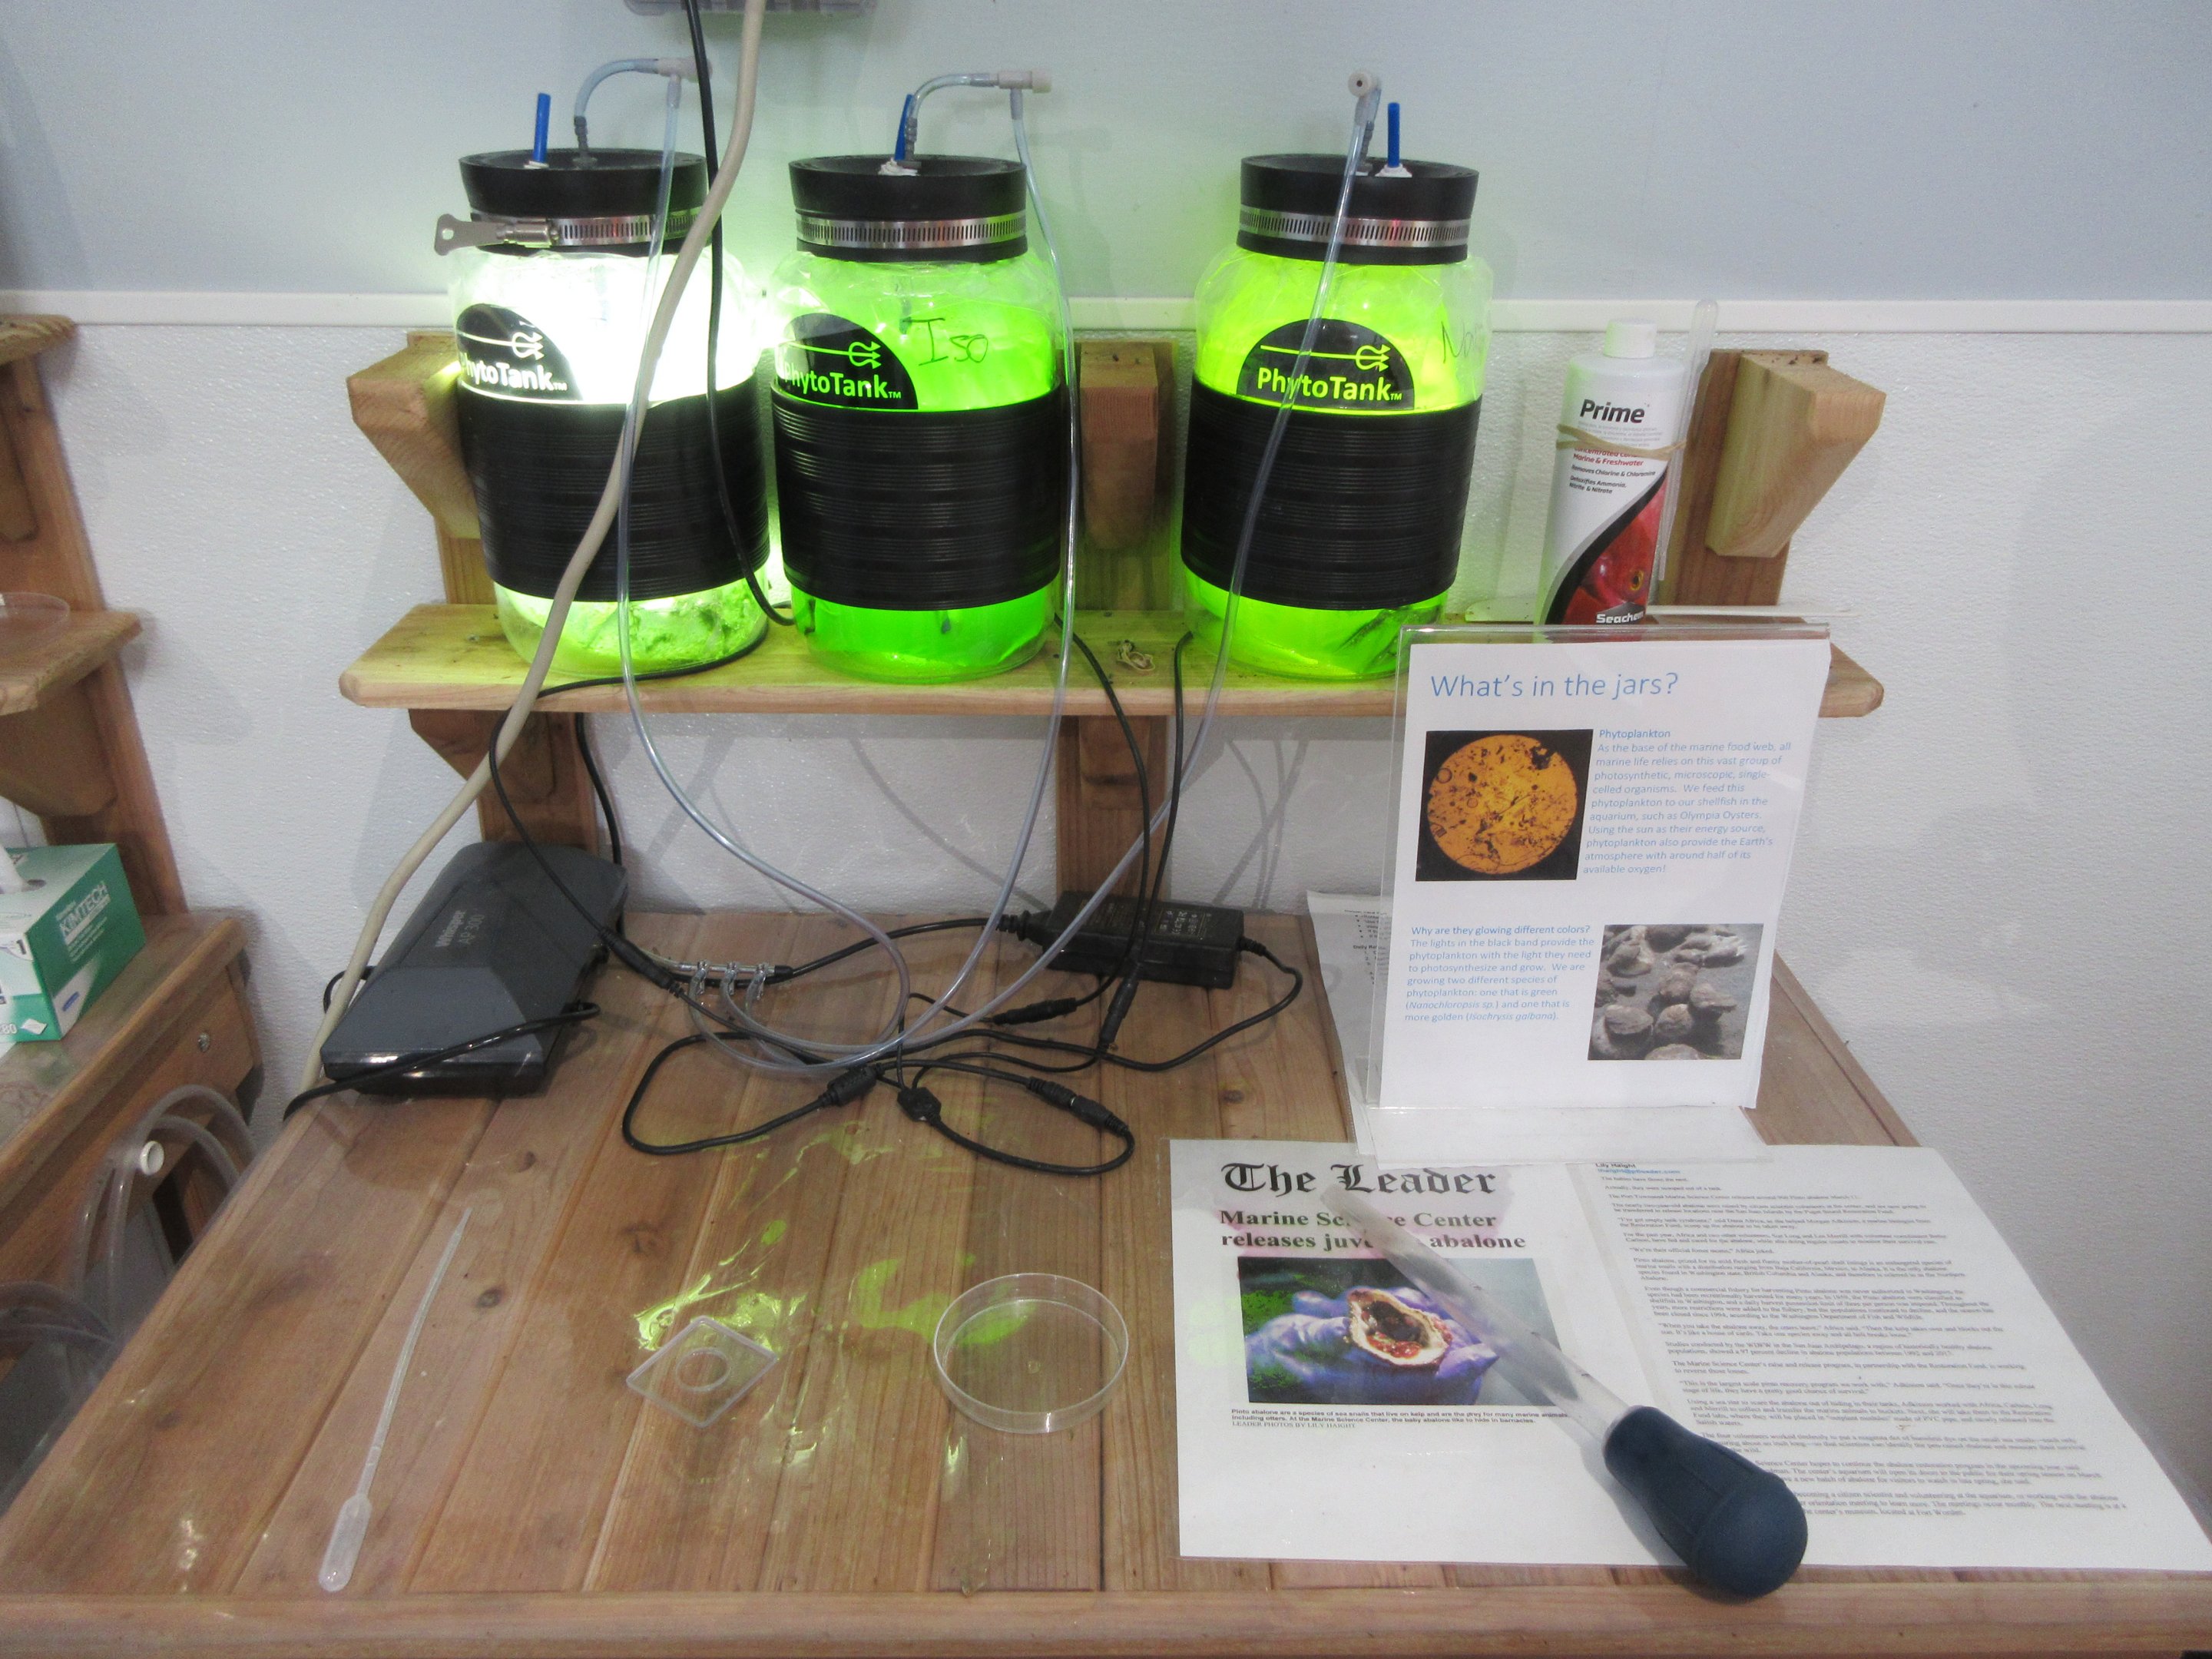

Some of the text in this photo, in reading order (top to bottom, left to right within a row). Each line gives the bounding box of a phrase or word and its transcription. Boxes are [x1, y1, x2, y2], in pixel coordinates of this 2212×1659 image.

[905, 317, 988, 366] Iso
[1580, 399, 1645, 423] Prime
[1573, 453, 1595, 462] Marine
[1571, 464, 1594, 474] Removes
[1570, 475, 1596, 485] Detoxifies
[1431, 672, 1678, 700] What's in the jars?
[1599, 728, 1671, 740] Phytoplankton
[1596, 741, 1791, 753] As the base of the marine food web, all
[1594, 757, 1631, 766] marine
[1633, 756, 1649, 766] life
[1651, 756, 1678, 765] relies
[1695, 756, 1716, 765] this
[1715, 756, 1738, 765] vast
[1737, 757, 1769, 767] group
[1770, 755, 1782, 764] of
[1673, 769, 1737, 781] microscopic,
[1737, 768, 1770, 780] single-
[1593, 782, 1744, 796] celled organisms. We feed this
[1590, 797, 1662, 810] phytoplankton
[1664, 797, 1675, 806] to
[1697, 796, 1737, 806] shellfish
[1739, 796, 1748, 806] in
[1751, 796, 1767, 806] the
[1589, 810, 1639, 823] aquarium,
[1641, 810, 1665, 820] such
[1679, 810, 1720, 822] Olympia
[1722, 810, 1762, 822] Oysters.
[1588, 824, 1614, 836] Using
[1616, 824, 1634, 833] the
[1668, 823, 1692, 833] their
[1694, 826, 1728, 836] energy
[1730, 826, 1765, 835] source,
[1585, 836, 1773, 849] phytoplankton also provide the Earth's
[1584, 849, 1751, 863] atmosphere with around half of its
[1583, 863, 1666, 875] available oxygen!
[1411, 925, 1433, 937] Why
[1452, 925, 1472, 936] they
[1475, 924, 1512, 936] glowing
[1514, 924, 1554, 934] different
[1556, 923, 1590, 933] colors?
[1409, 936, 1594, 949] The lights in the black band provide the
[1409, 949, 1592, 962] phytoplankton with the light they need
[1407, 962, 1419, 972] to
[1419, 962, 1497, 974] photosynthesize
[1499, 962, 1518, 972] and
[1518, 964, 1545, 974] grow.
[1550, 962, 1568, 971] We
[1406, 974, 1558, 986] growing two different species of
[1498, 986, 1520, 996] that
[1520, 986, 1529, 995] is
[1529, 988, 1558, 998] green
[1404, 998, 1479, 1011] (Nanochloropsis
[1481, 998, 1498, 1011] sp.)
[1501, 998, 1519, 1008] and
[1540, 998, 1561, 1008] that
[1561, 998, 1570, 1008] is
[1430, 1012, 1463, 1023] golden
[1465, 1011, 1513, 1023] (Isochrysis
[1514, 1010, 1558, 1022] galbana).
[1221, 1163, 1495, 1197] The Leader
[1219, 1210, 1308, 1227] Marine
[1414, 1212, 1496, 1227] Center
[1222, 1233, 1316, 1248] releases
[1430, 1235, 1527, 1248] abalone
